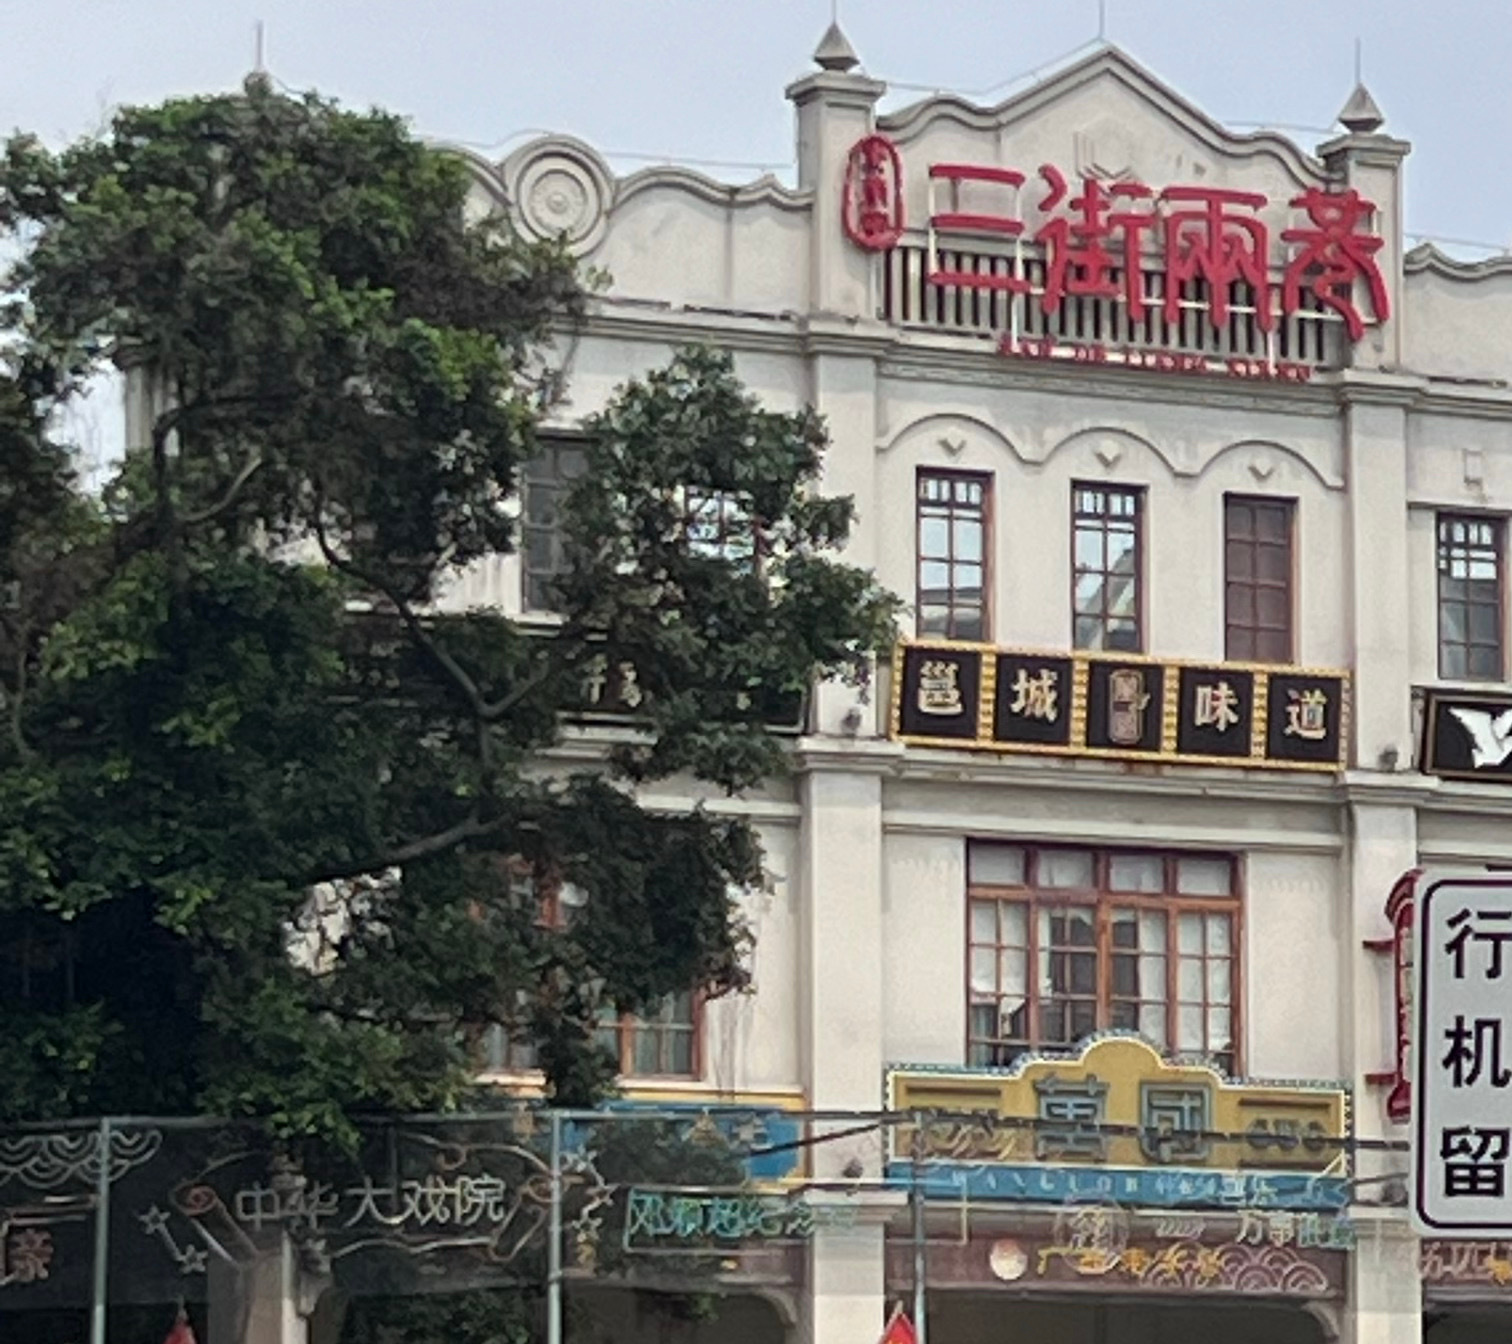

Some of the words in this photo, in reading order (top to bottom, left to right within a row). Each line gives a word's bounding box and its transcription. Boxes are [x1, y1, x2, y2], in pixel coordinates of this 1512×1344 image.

[236, 1173, 506, 1233] 中华大戏院
